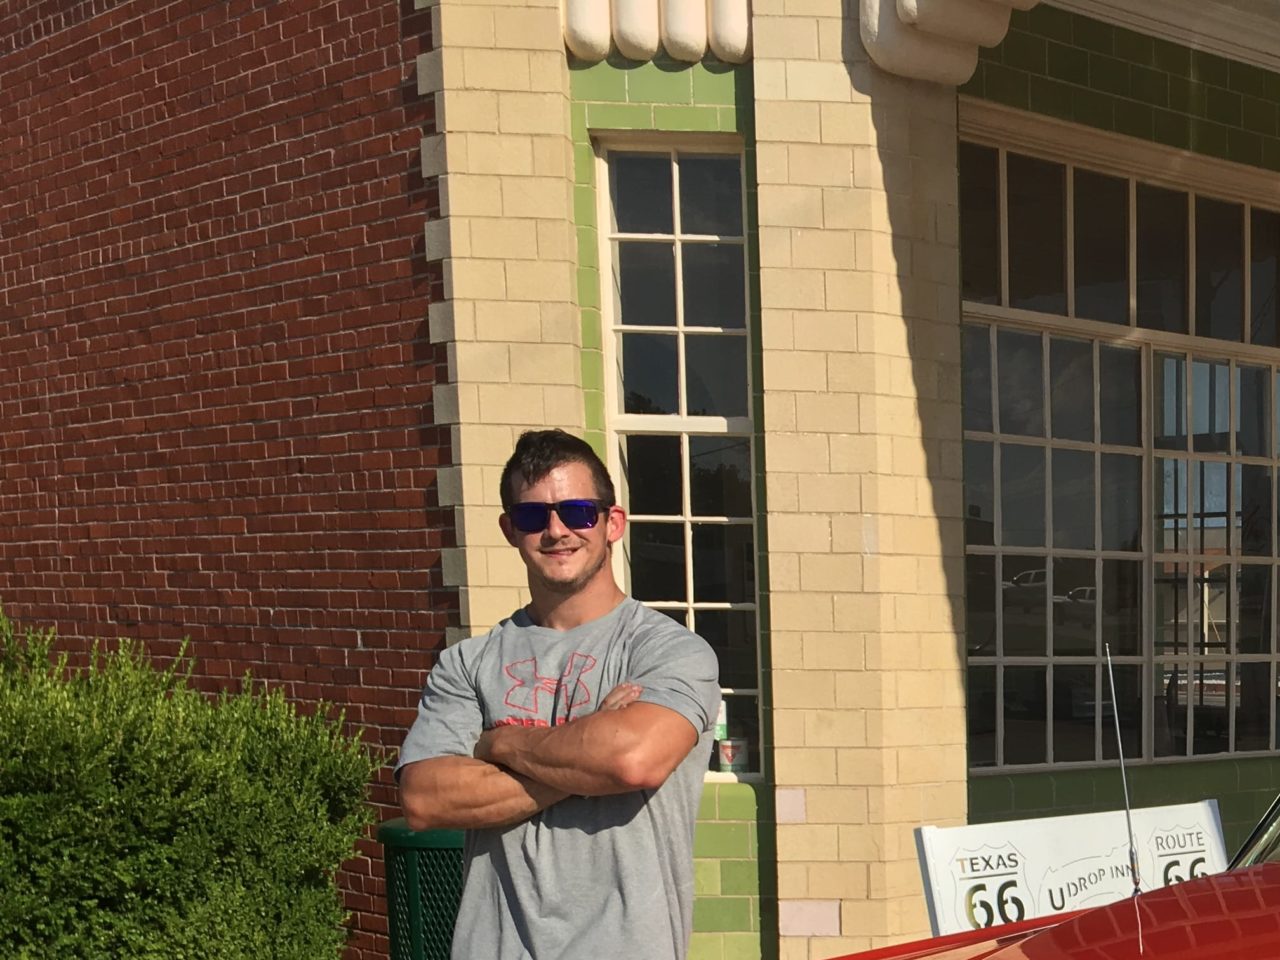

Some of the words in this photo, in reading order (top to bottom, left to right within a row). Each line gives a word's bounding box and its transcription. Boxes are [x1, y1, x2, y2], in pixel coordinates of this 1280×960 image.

[1155, 831, 1205, 851] ROUTE
[955, 852, 1019, 874] TEXAS
[964, 879, 1025, 930] 66
